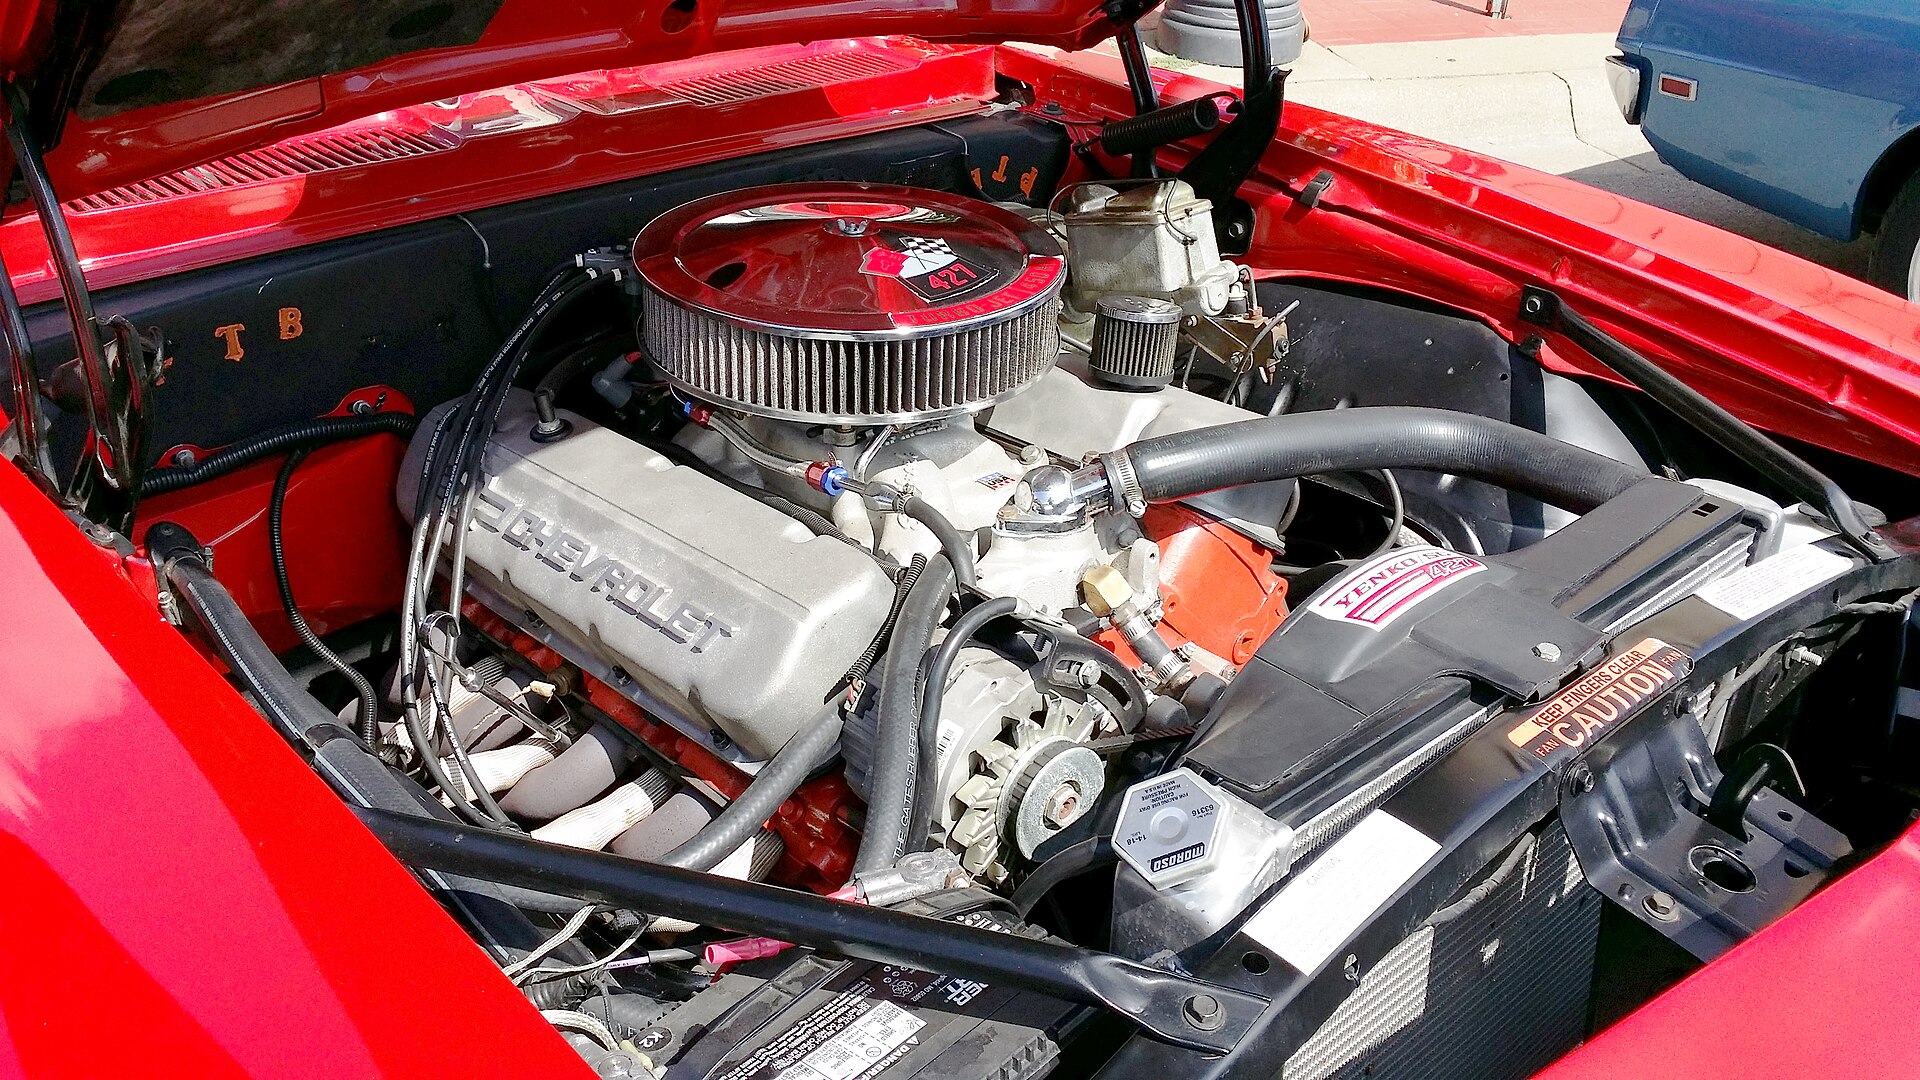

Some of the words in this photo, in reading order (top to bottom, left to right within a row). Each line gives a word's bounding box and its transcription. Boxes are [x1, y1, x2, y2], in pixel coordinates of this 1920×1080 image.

[928, 263, 978, 290] 427
[214, 323, 245, 362] T
[278, 307, 304, 340] B
[502, 329, 523, 354] CONDUCTOR
[1428, 557, 1474, 580] 427
[502, 511, 740, 654] CHEVROLET
[1334, 558, 1418, 608] YENKO
[1532, 704, 1564, 728] KEEP
[1566, 671, 1614, 708] FINGERS
[1608, 650, 1646, 675] CLEAR
[1536, 738, 1560, 757] FAN
[1552, 658, 1675, 748] CAUTION
[1660, 650, 1682, 666] FAN
[906, 722, 921, 775] RUBBER
[900, 778, 914, 826] GATES
[1141, 787, 1168, 802] PRESSURE
[1192, 804, 1214, 816] 63316
[892, 826, 906, 858] THE
[1126, 834, 1147, 846] 14-18
[1152, 844, 1204, 872] MOROSO
[1306, 856, 1340, 886] CAUTION
[843, 1014, 856, 1025] OUT
[855, 1003, 871, 1016] KEEP
[638, 1030, 664, 1048] K2
[797, 1037, 815, 1051] OPEN
